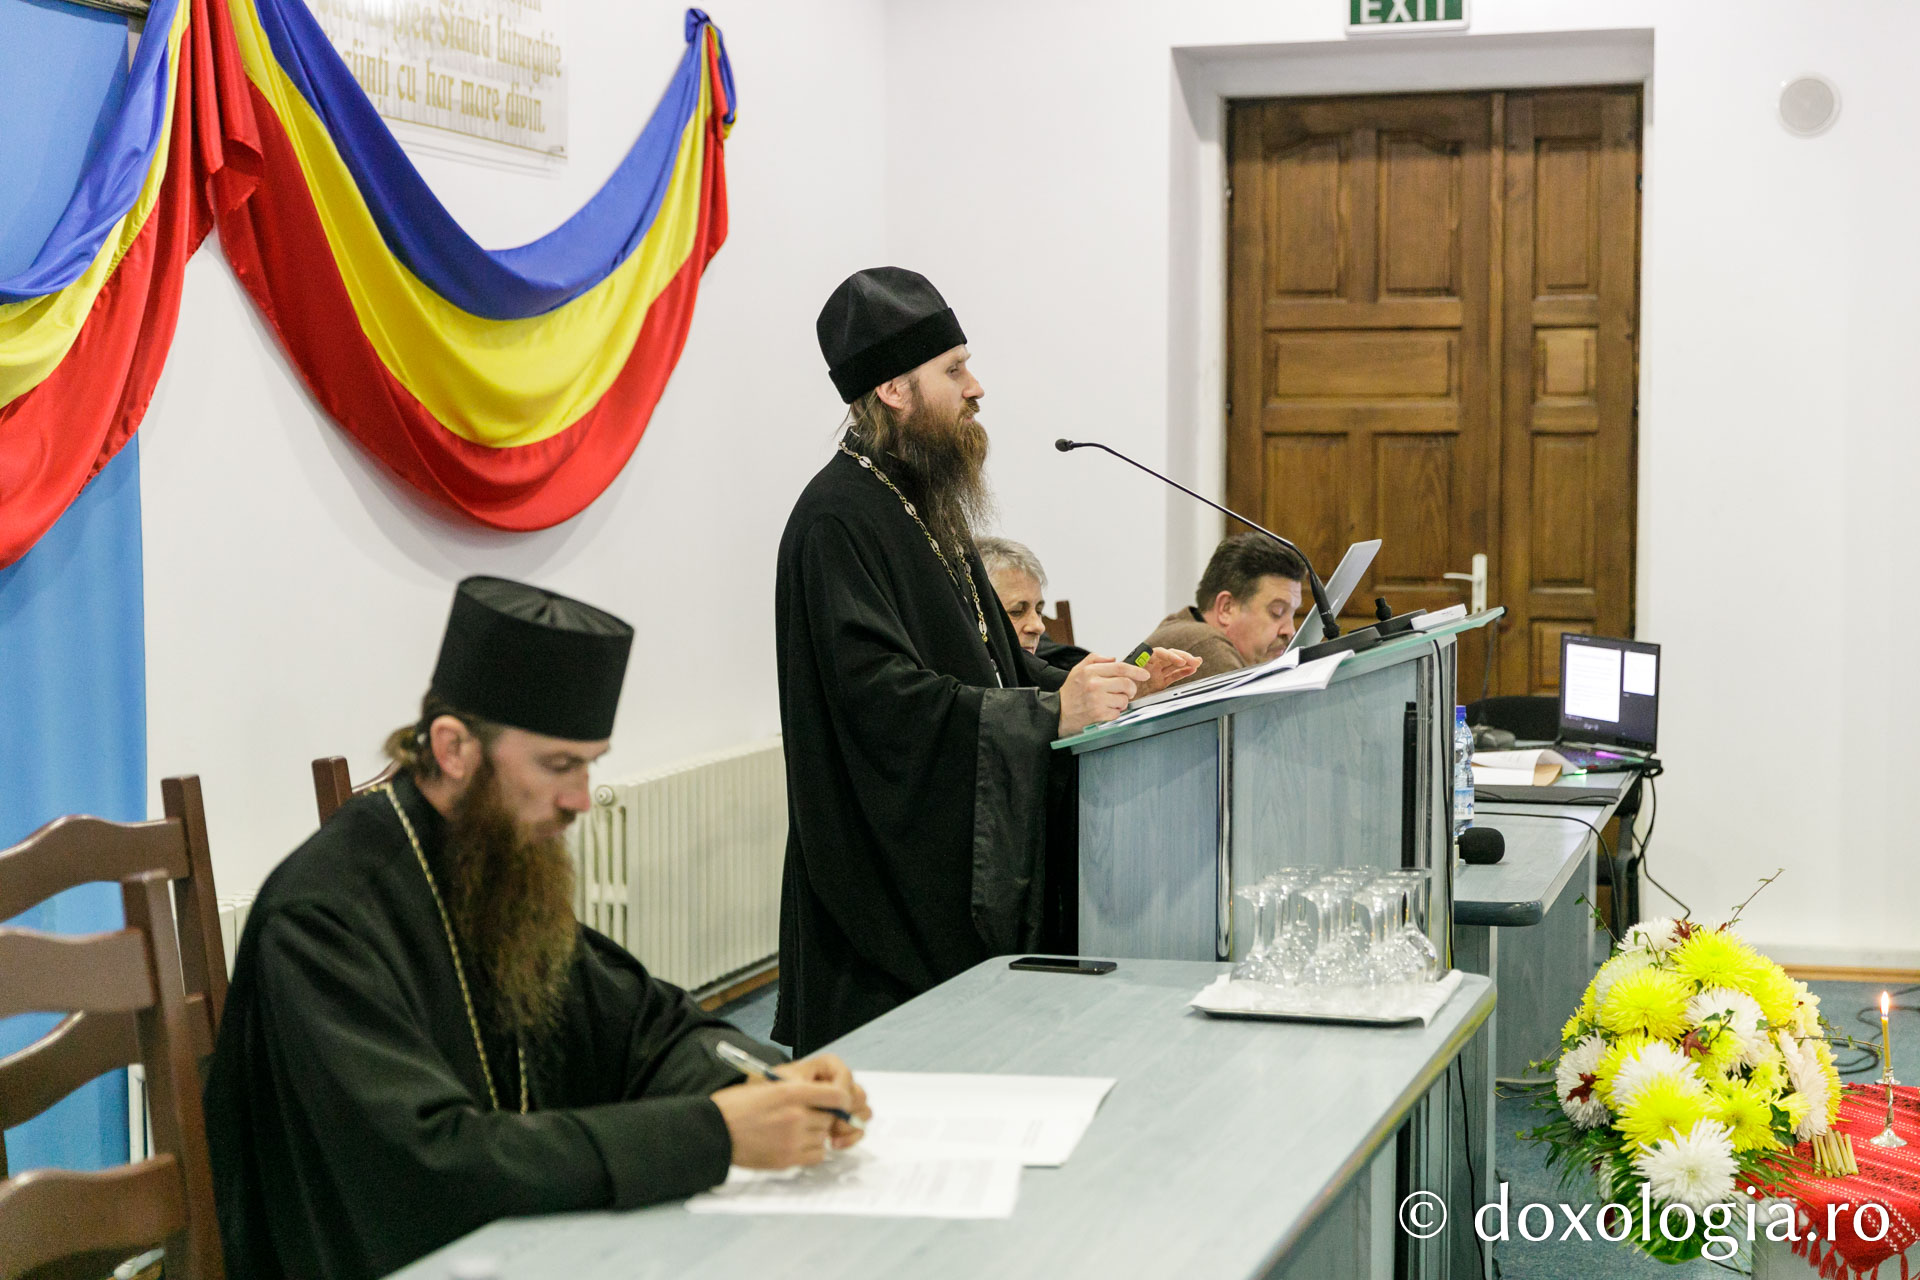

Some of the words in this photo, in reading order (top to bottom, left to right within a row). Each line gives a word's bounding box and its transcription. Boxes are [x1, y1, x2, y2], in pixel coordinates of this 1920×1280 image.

[397, 63, 417, 103] cu
[425, 57, 454, 112] har
[460, 79, 500, 122] mare
